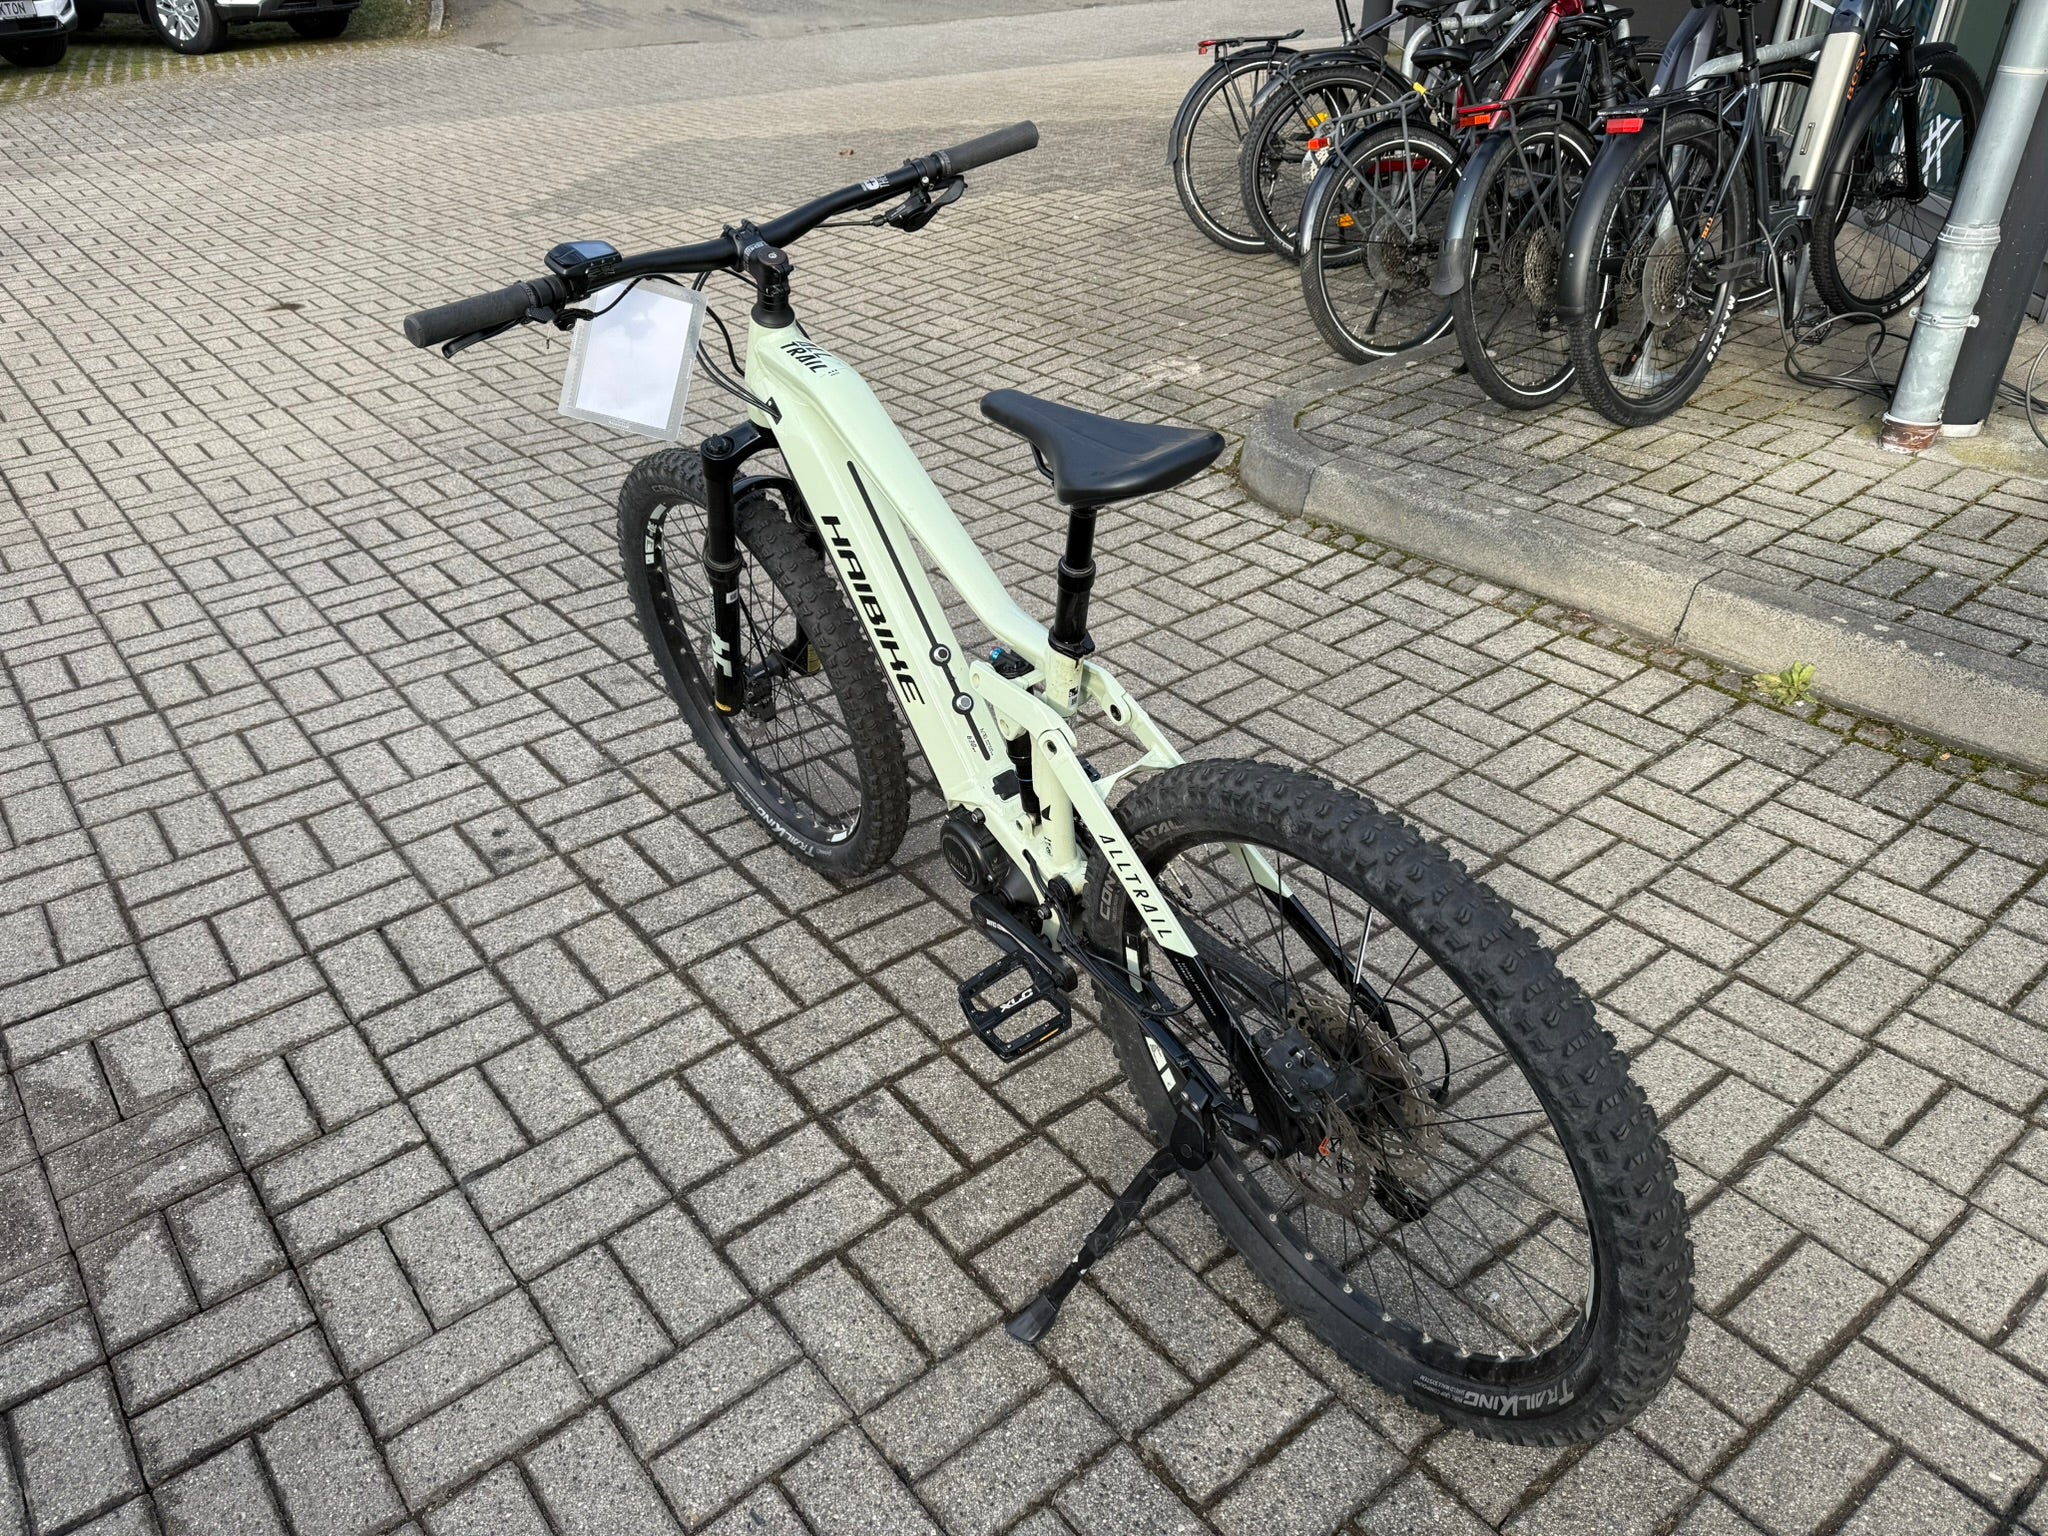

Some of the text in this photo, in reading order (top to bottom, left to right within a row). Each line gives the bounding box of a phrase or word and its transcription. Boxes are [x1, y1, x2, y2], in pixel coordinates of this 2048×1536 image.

[780, 341, 828, 373] TRAIL
[1706, 295, 1736, 362] MAXXIS
[820, 515, 926, 705] HAIBIKE
[1098, 834, 1173, 939] ALLTRAIL
[1000, 988, 1034, 1013] XLC
